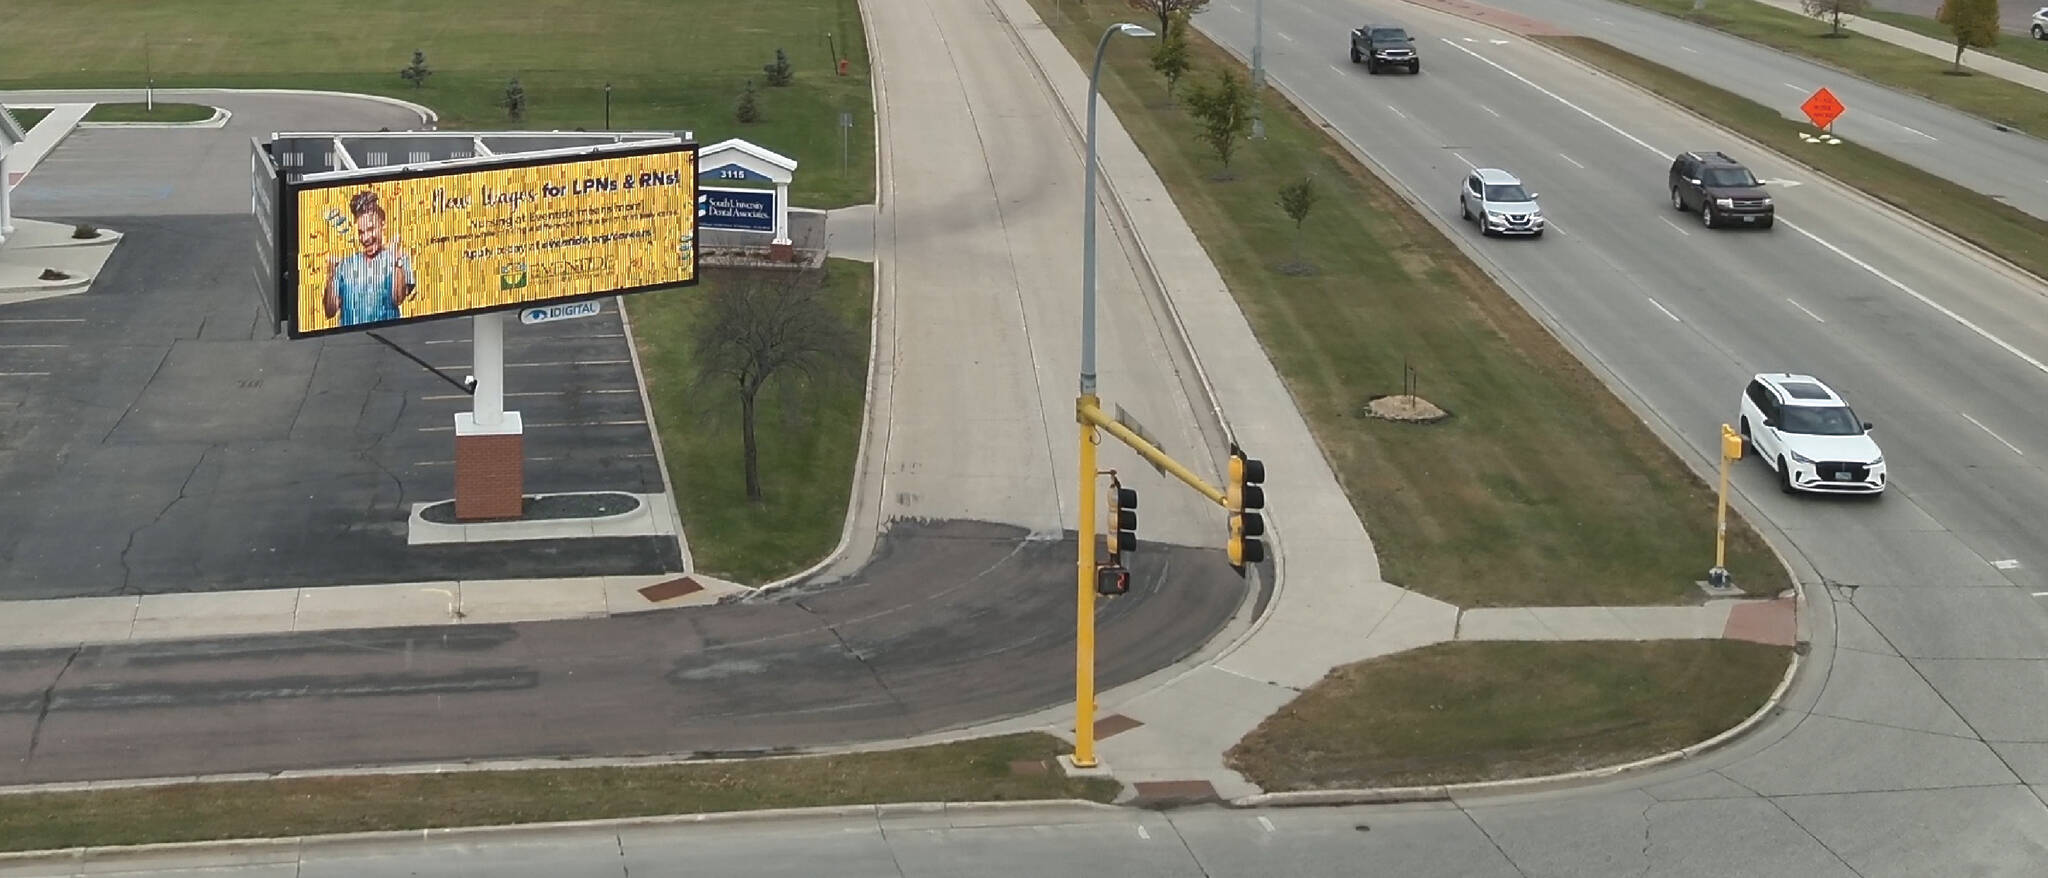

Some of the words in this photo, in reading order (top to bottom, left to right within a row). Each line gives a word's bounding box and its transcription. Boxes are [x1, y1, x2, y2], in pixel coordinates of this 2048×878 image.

[720, 170, 745, 179] 3115
[542, 182, 566, 198] for
[572, 178, 618, 195] LPNs
[623, 174, 635, 189] &
[639, 169, 680, 188] RNs!
[709, 197, 730, 207] South
[730, 199, 764, 210] University
[708, 206, 732, 216] Dental
